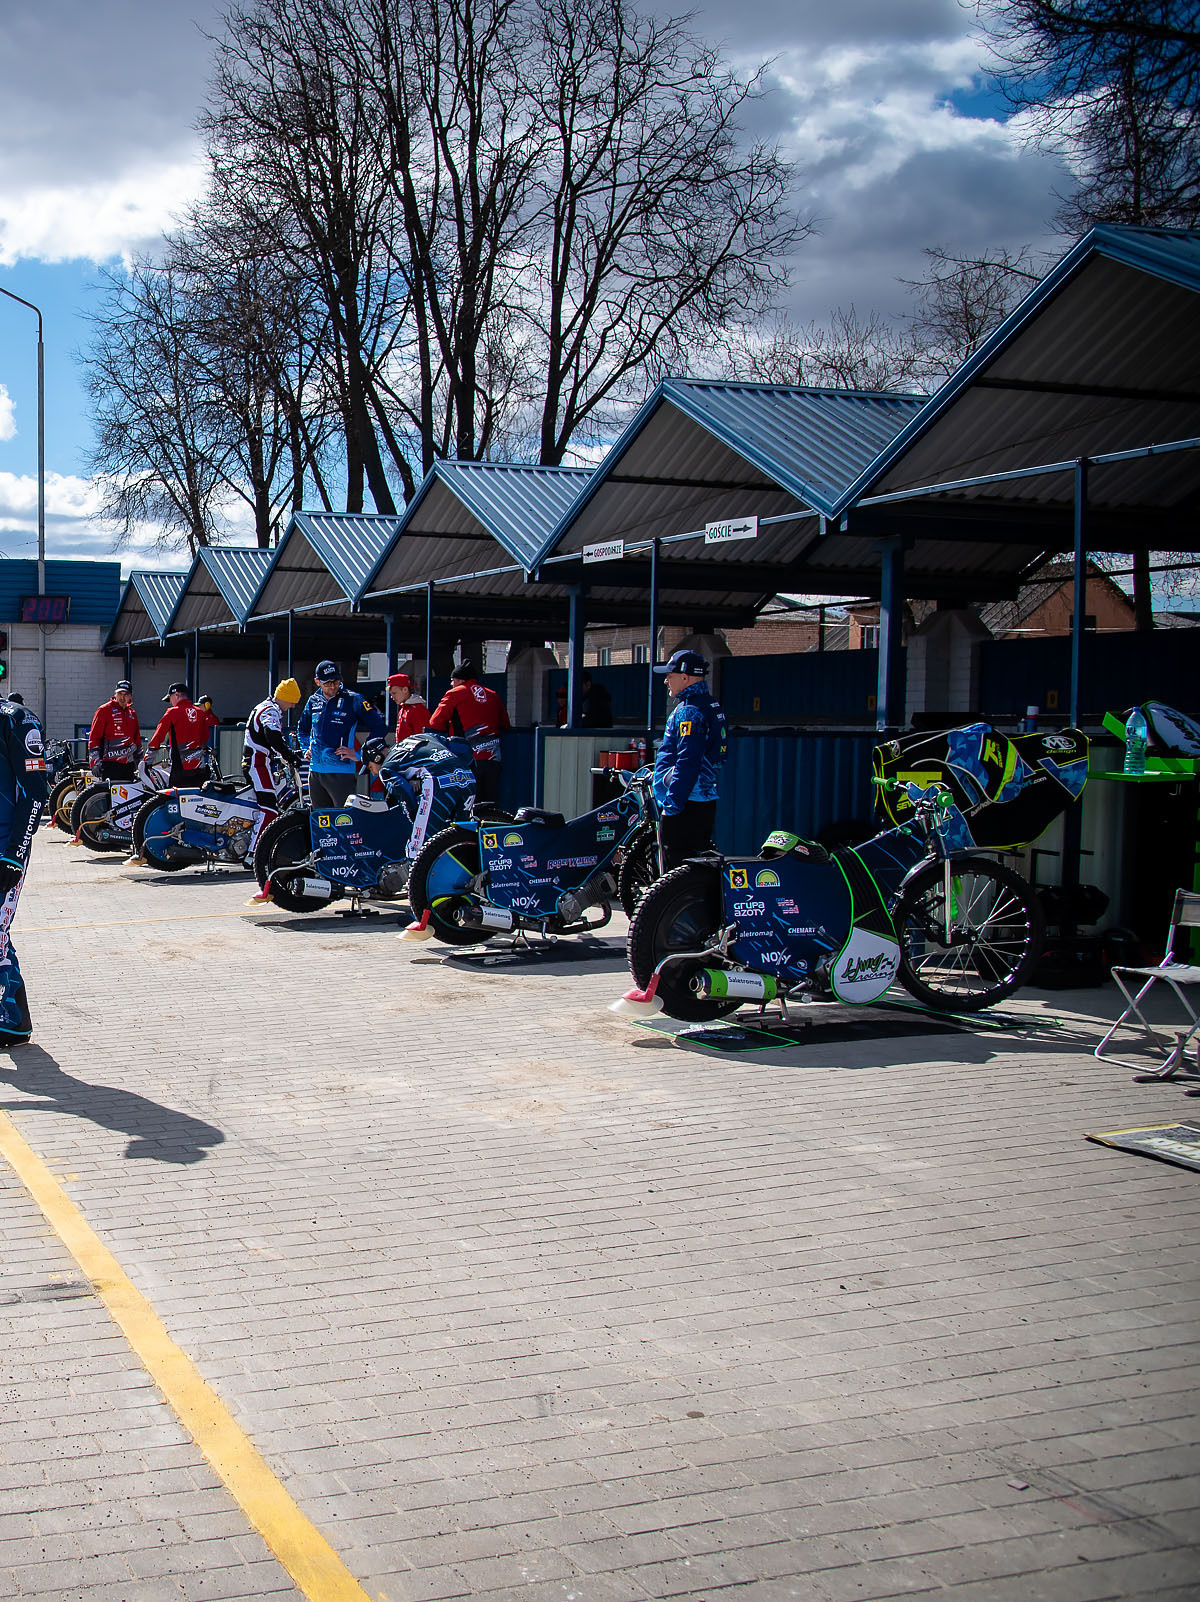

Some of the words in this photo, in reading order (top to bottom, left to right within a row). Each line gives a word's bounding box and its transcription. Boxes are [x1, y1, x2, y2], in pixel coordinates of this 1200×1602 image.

[708, 523, 732, 540] GOŚCIE
[594, 544, 622, 558] GOSPODARZE
[168, 804, 178, 814] 33
[15, 800, 41, 859] Saletromag
[739, 930, 774, 939] aletromag
[787, 927, 816, 935] CHEMART
[728, 976, 763, 986] Saletromag
